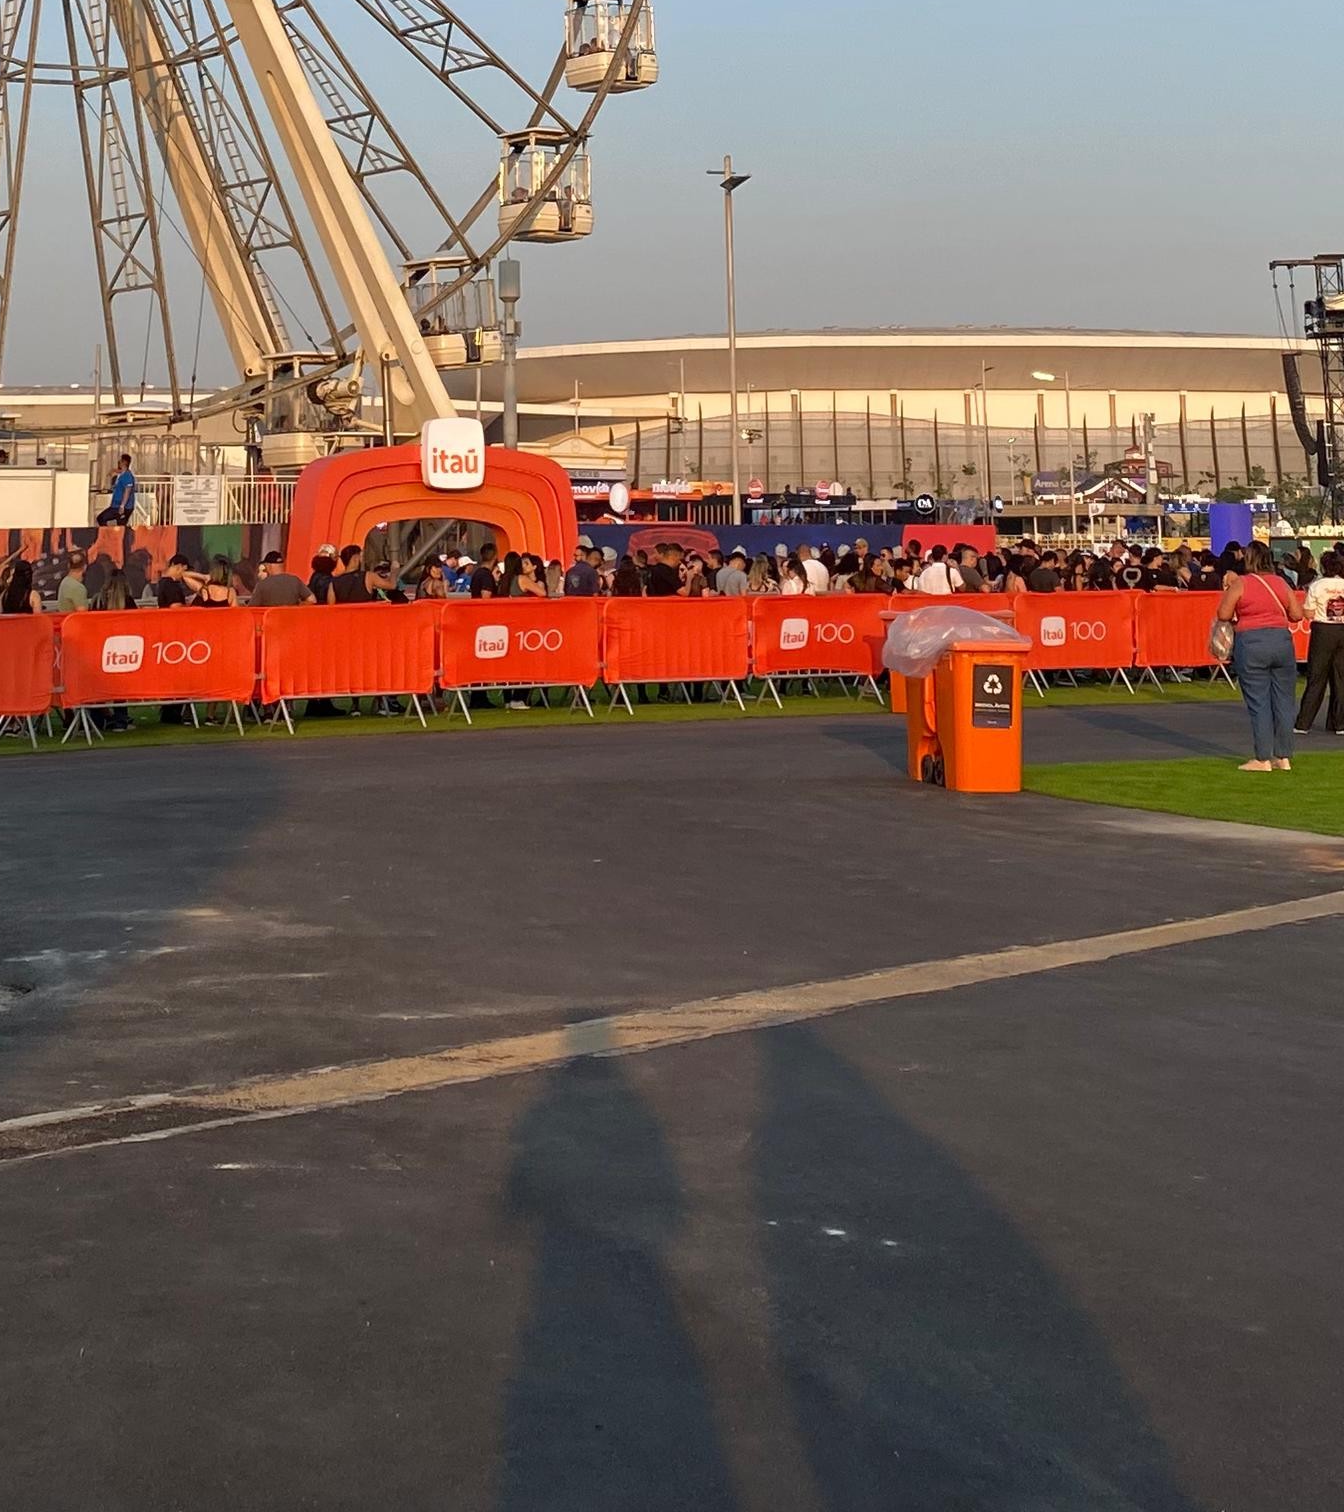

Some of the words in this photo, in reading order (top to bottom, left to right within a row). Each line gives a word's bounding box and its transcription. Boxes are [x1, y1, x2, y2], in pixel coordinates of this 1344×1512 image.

[432, 447, 479, 474] itaú
[478, 639, 505, 652] itaú
[515, 629, 563, 651] 100
[814, 623, 855, 644] 100
[1069, 621, 1106, 641] 100
[106, 650, 139, 666] itaú
[151, 640, 211, 665] 100
